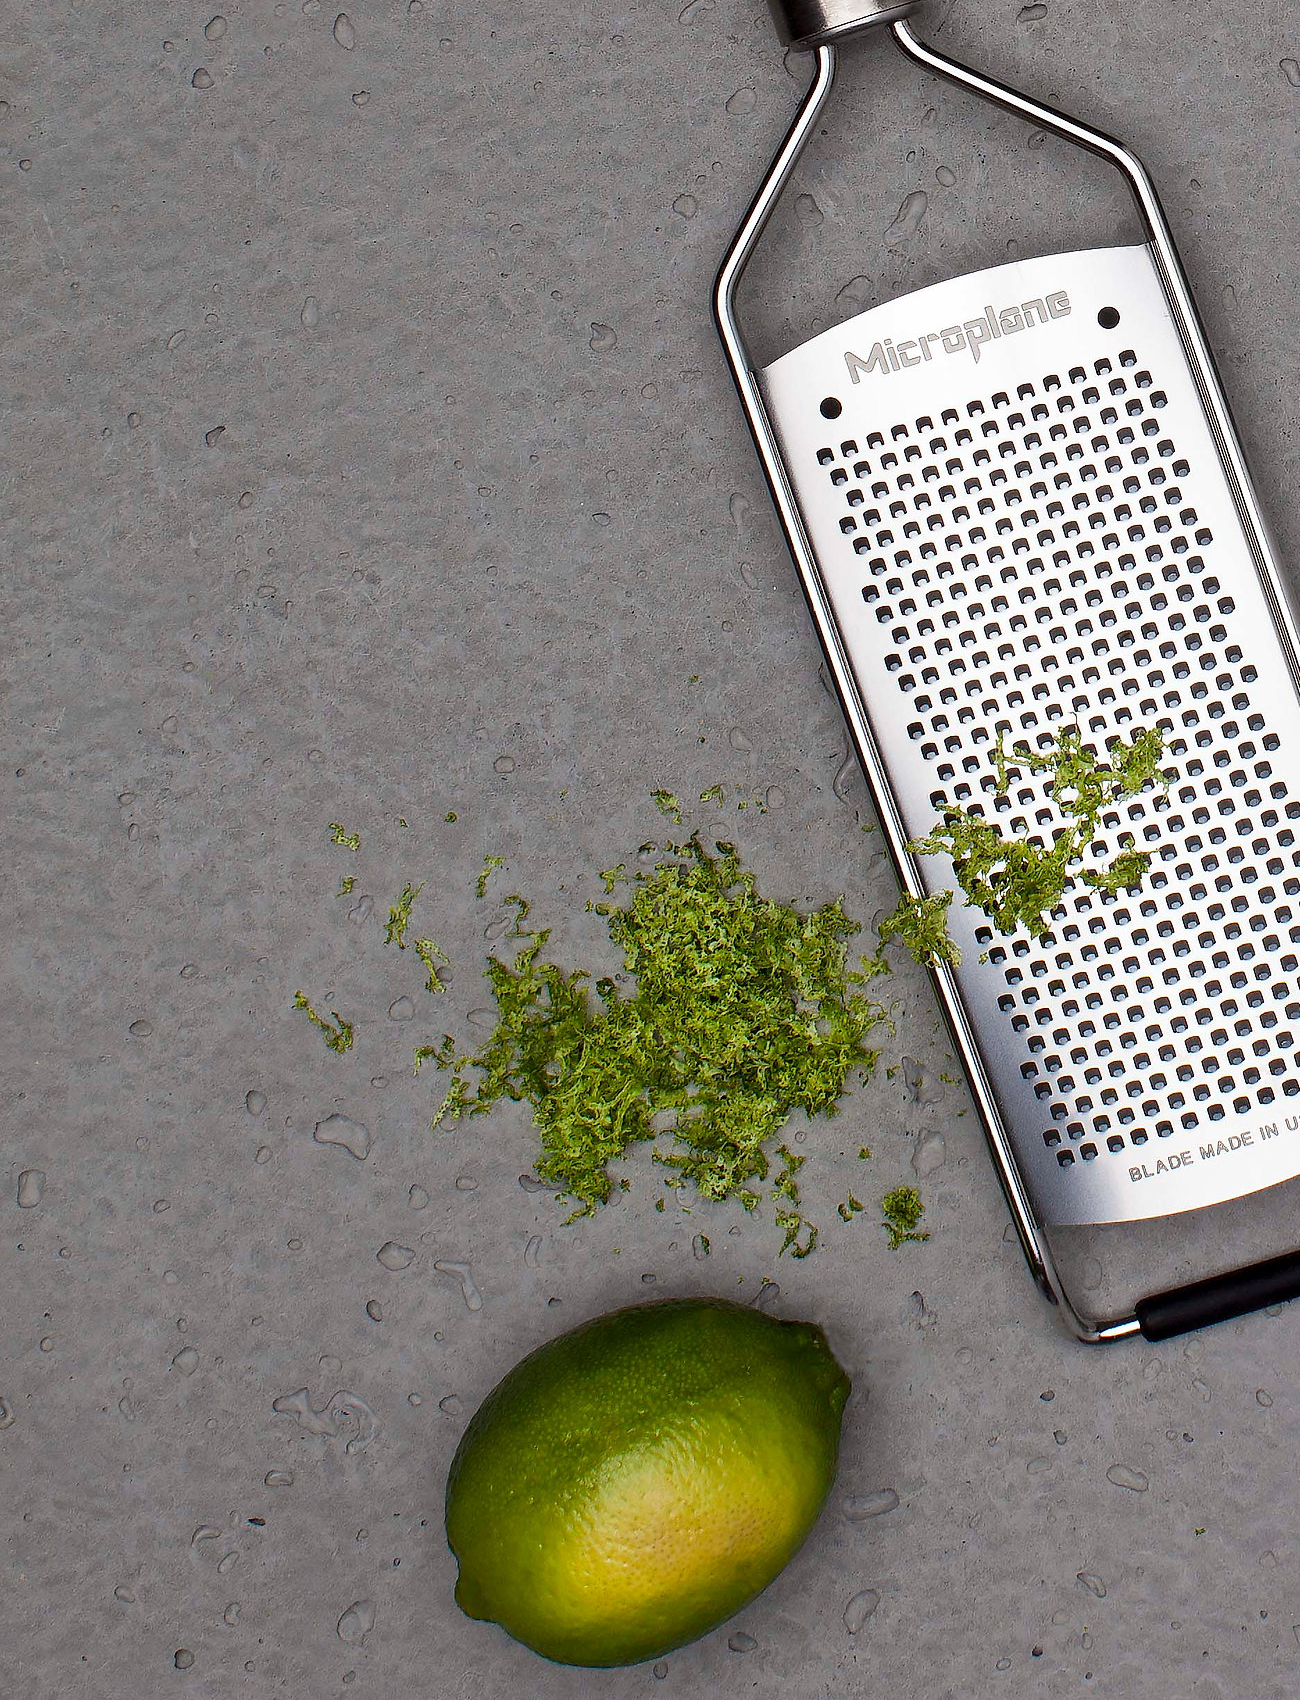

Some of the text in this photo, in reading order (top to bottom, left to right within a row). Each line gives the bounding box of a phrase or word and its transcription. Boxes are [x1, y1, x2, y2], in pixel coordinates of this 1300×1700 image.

[844, 290, 1072, 384] Microplane
[1128, 1150, 1194, 1183] BLADE
[1199, 1131, 1255, 1160] MADE
[1259, 1122, 1280, 1141] IN
